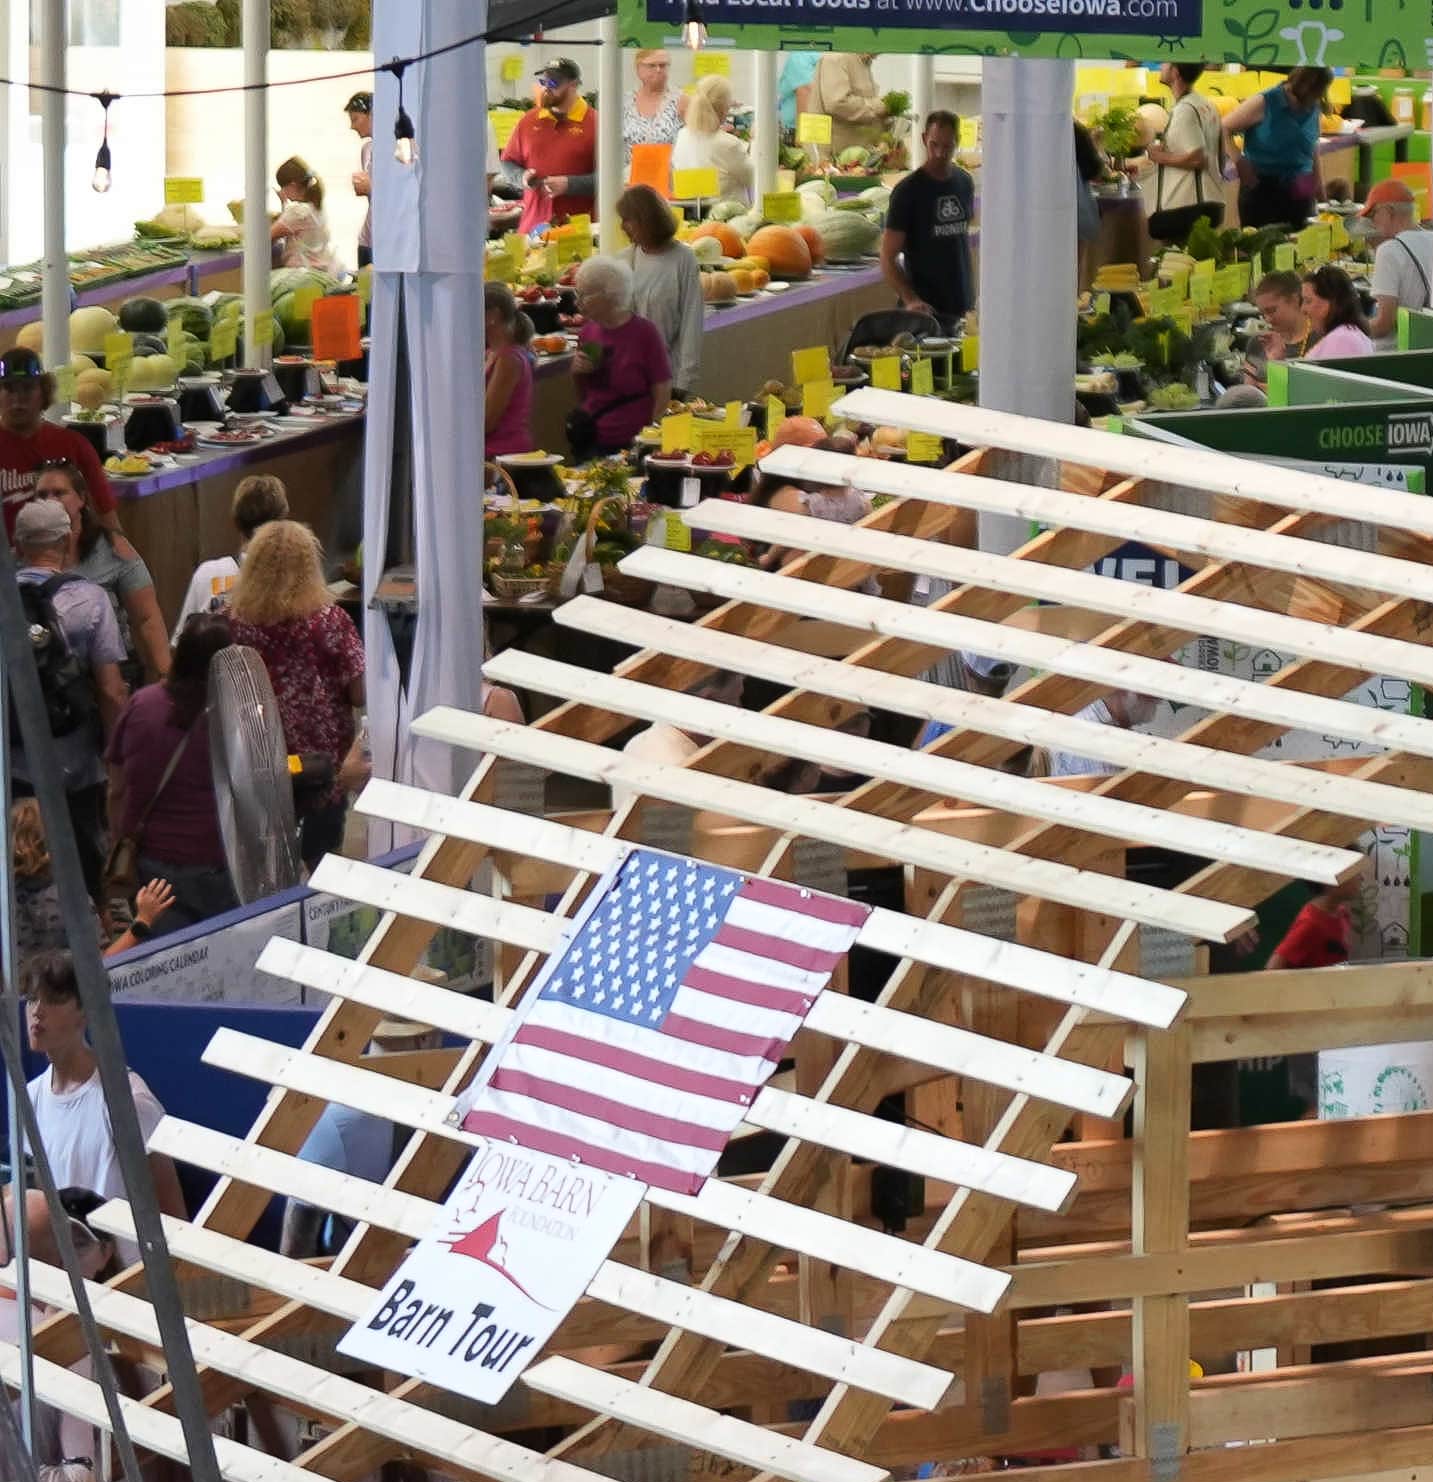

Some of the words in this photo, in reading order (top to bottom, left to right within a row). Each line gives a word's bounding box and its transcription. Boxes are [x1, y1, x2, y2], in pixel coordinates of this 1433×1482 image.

[1319, 426, 1384, 449] CHOOSE
[1388, 422, 1432, 445] IOWA
[469, 1152, 532, 1200] IOWA
[527, 1164, 606, 1216] BARN
[368, 1279, 454, 1349] Barn
[448, 1302, 535, 1372] Tour
